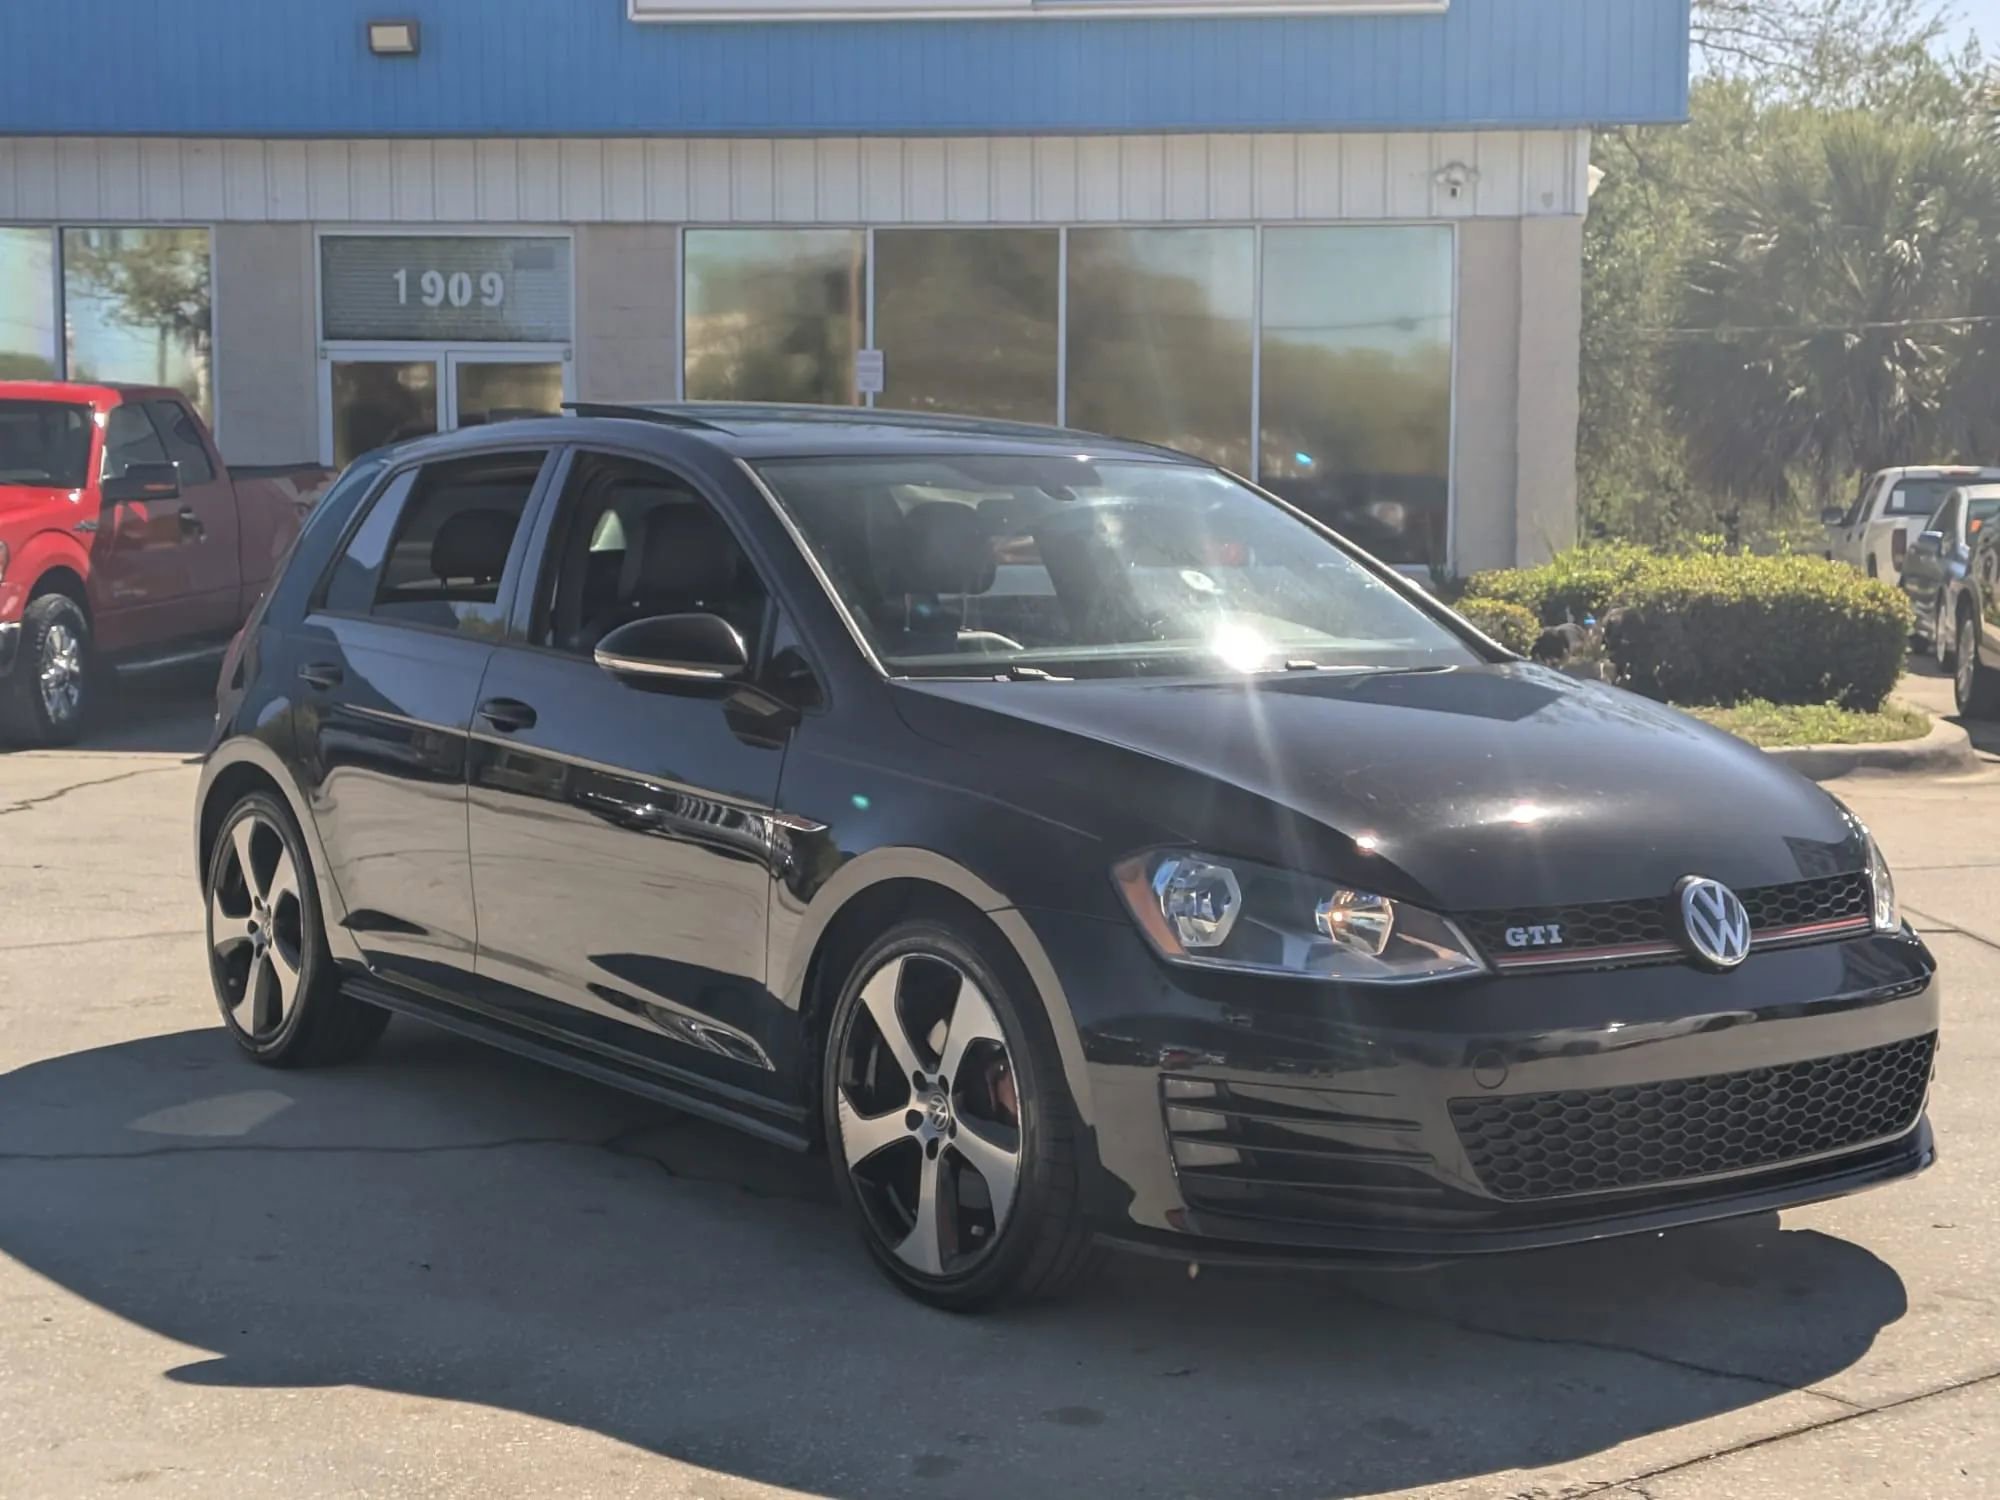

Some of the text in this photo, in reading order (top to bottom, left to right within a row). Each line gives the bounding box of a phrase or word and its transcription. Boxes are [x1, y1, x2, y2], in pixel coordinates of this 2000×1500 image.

[393, 268, 504, 307] 1909
[1505, 924, 1563, 947] GTI
[1684, 880, 1749, 963] VW
